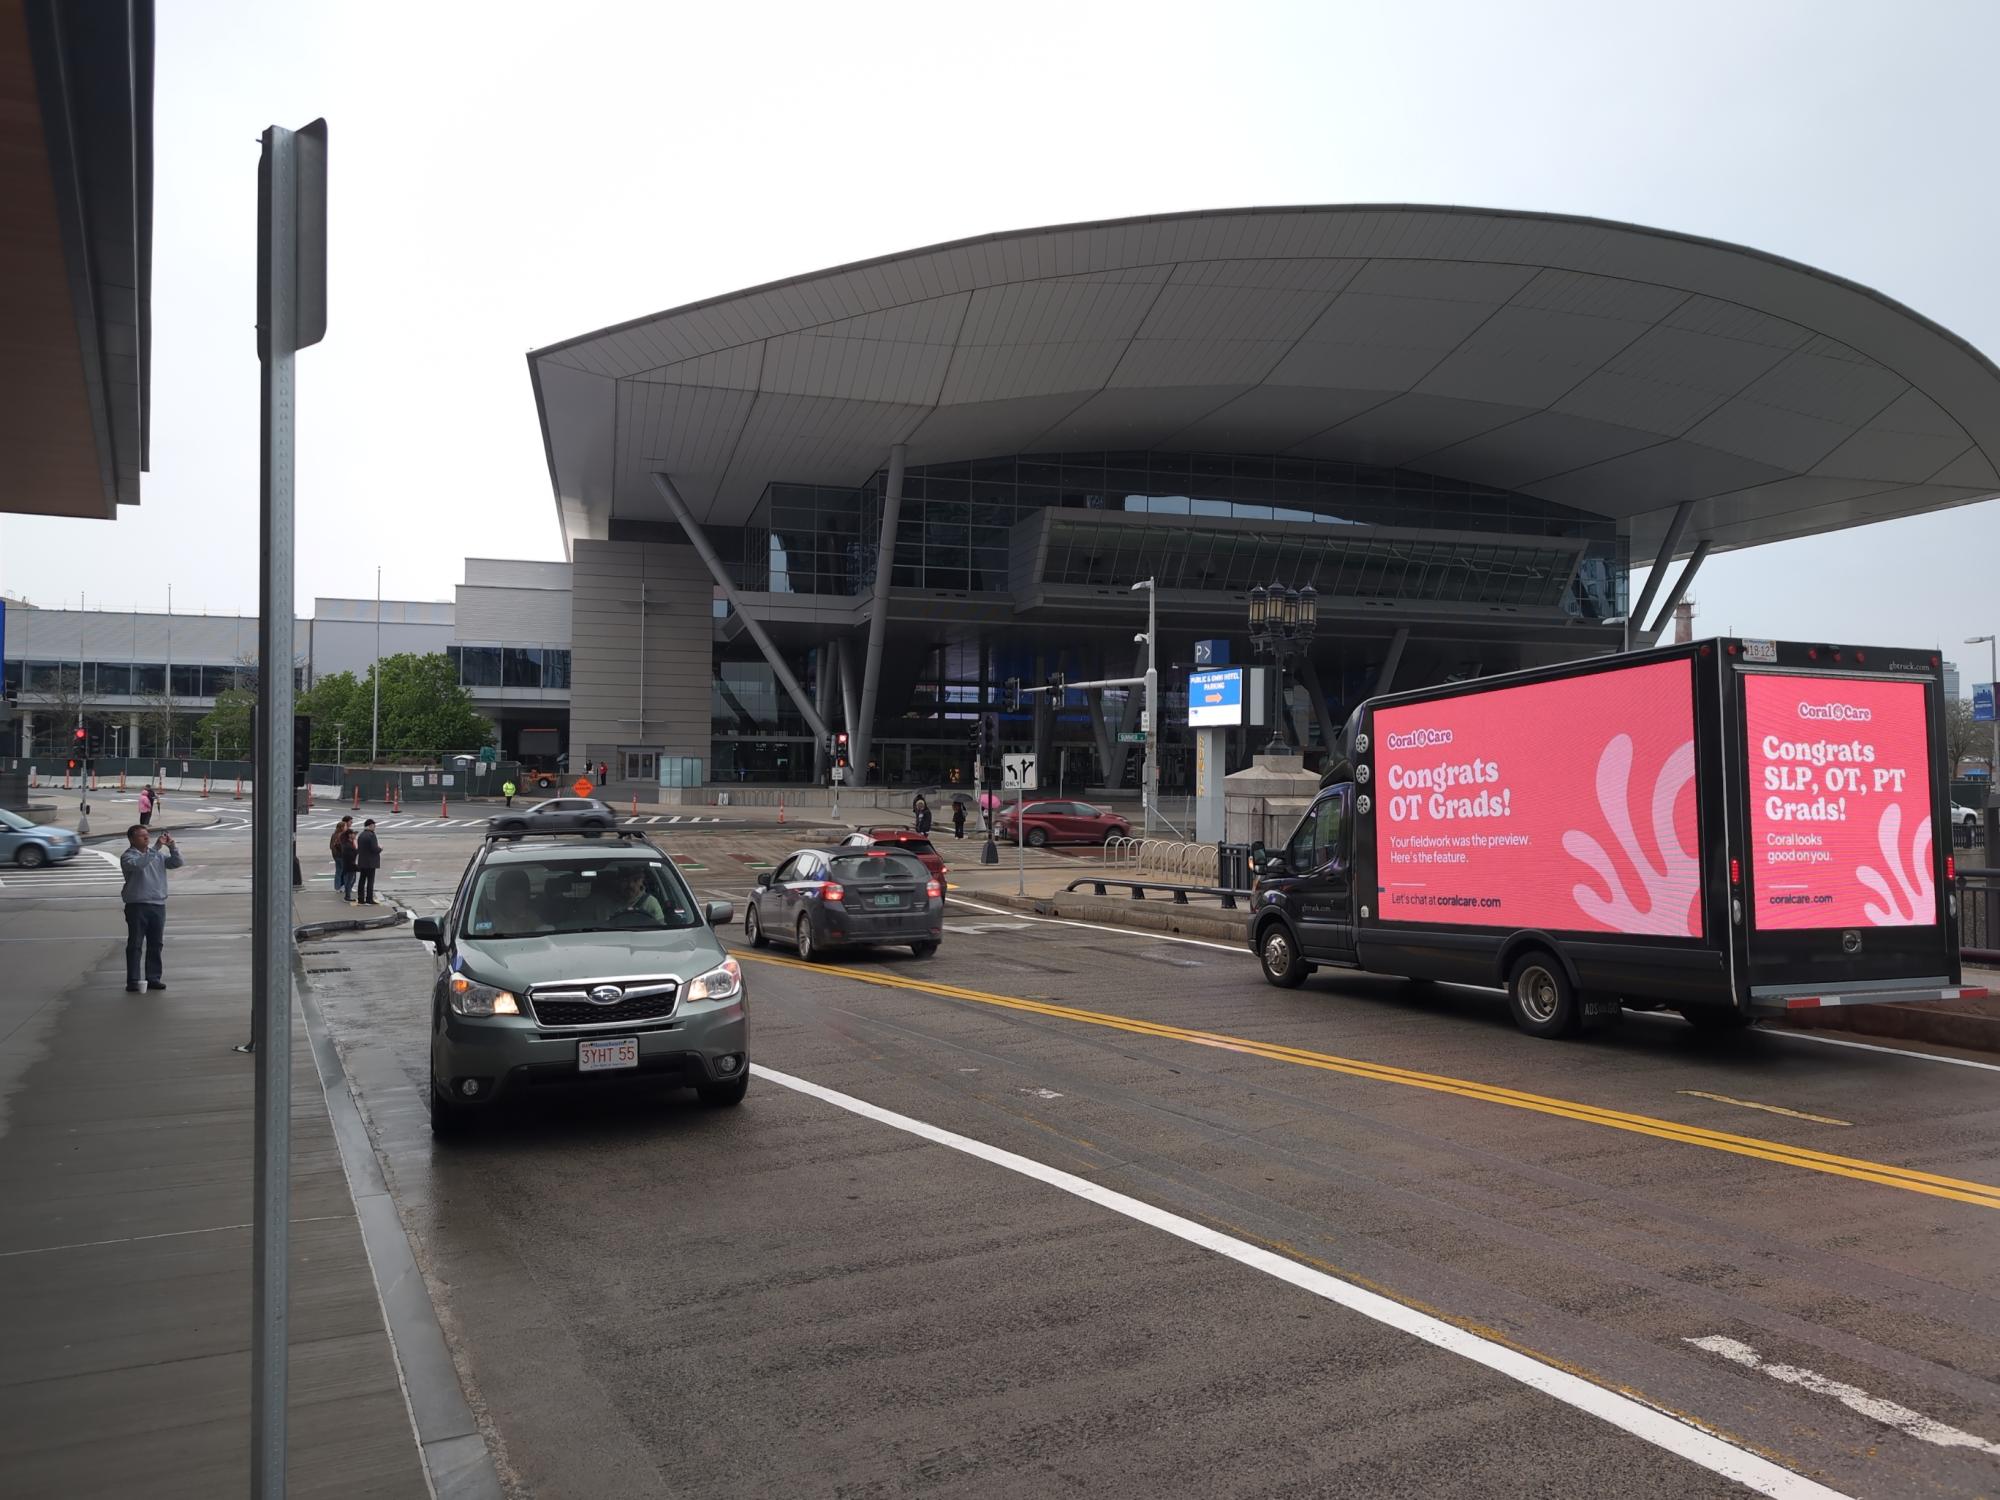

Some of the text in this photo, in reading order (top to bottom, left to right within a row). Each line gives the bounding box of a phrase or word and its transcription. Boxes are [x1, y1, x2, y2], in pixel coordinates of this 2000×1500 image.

[1196, 645, 1202, 663] P
[1888, 660, 1930, 671] gbtruck.com
[1190, 676, 1207, 684] PUBLIC
[1224, 672, 1240, 680] HOTEL
[1203, 682, 1225, 691] PARKING
[1799, 703, 1870, 719] Coral Care
[1388, 730, 1452, 748] Coral Care
[1762, 735, 1875, 767] Congrats
[1388, 757, 1499, 793] Congrats
[1764, 766, 1906, 796] SLP, OT, PT
[1389, 788, 1511, 822] OT Grads!
[1765, 795, 1846, 821] Grads!
[1390, 833, 1532, 849] Your fieldwork was the preview.
[1767, 832, 1823, 846] Coral looks
[1390, 850, 1469, 863] Here's the feature.
[1767, 849, 1833, 865] good on you.
[1391, 893, 1502, 908] Let's chat at coralcare.com
[1769, 893, 1833, 905] coralcare.com
[582, 1046, 635, 1064] 3YHT 55
